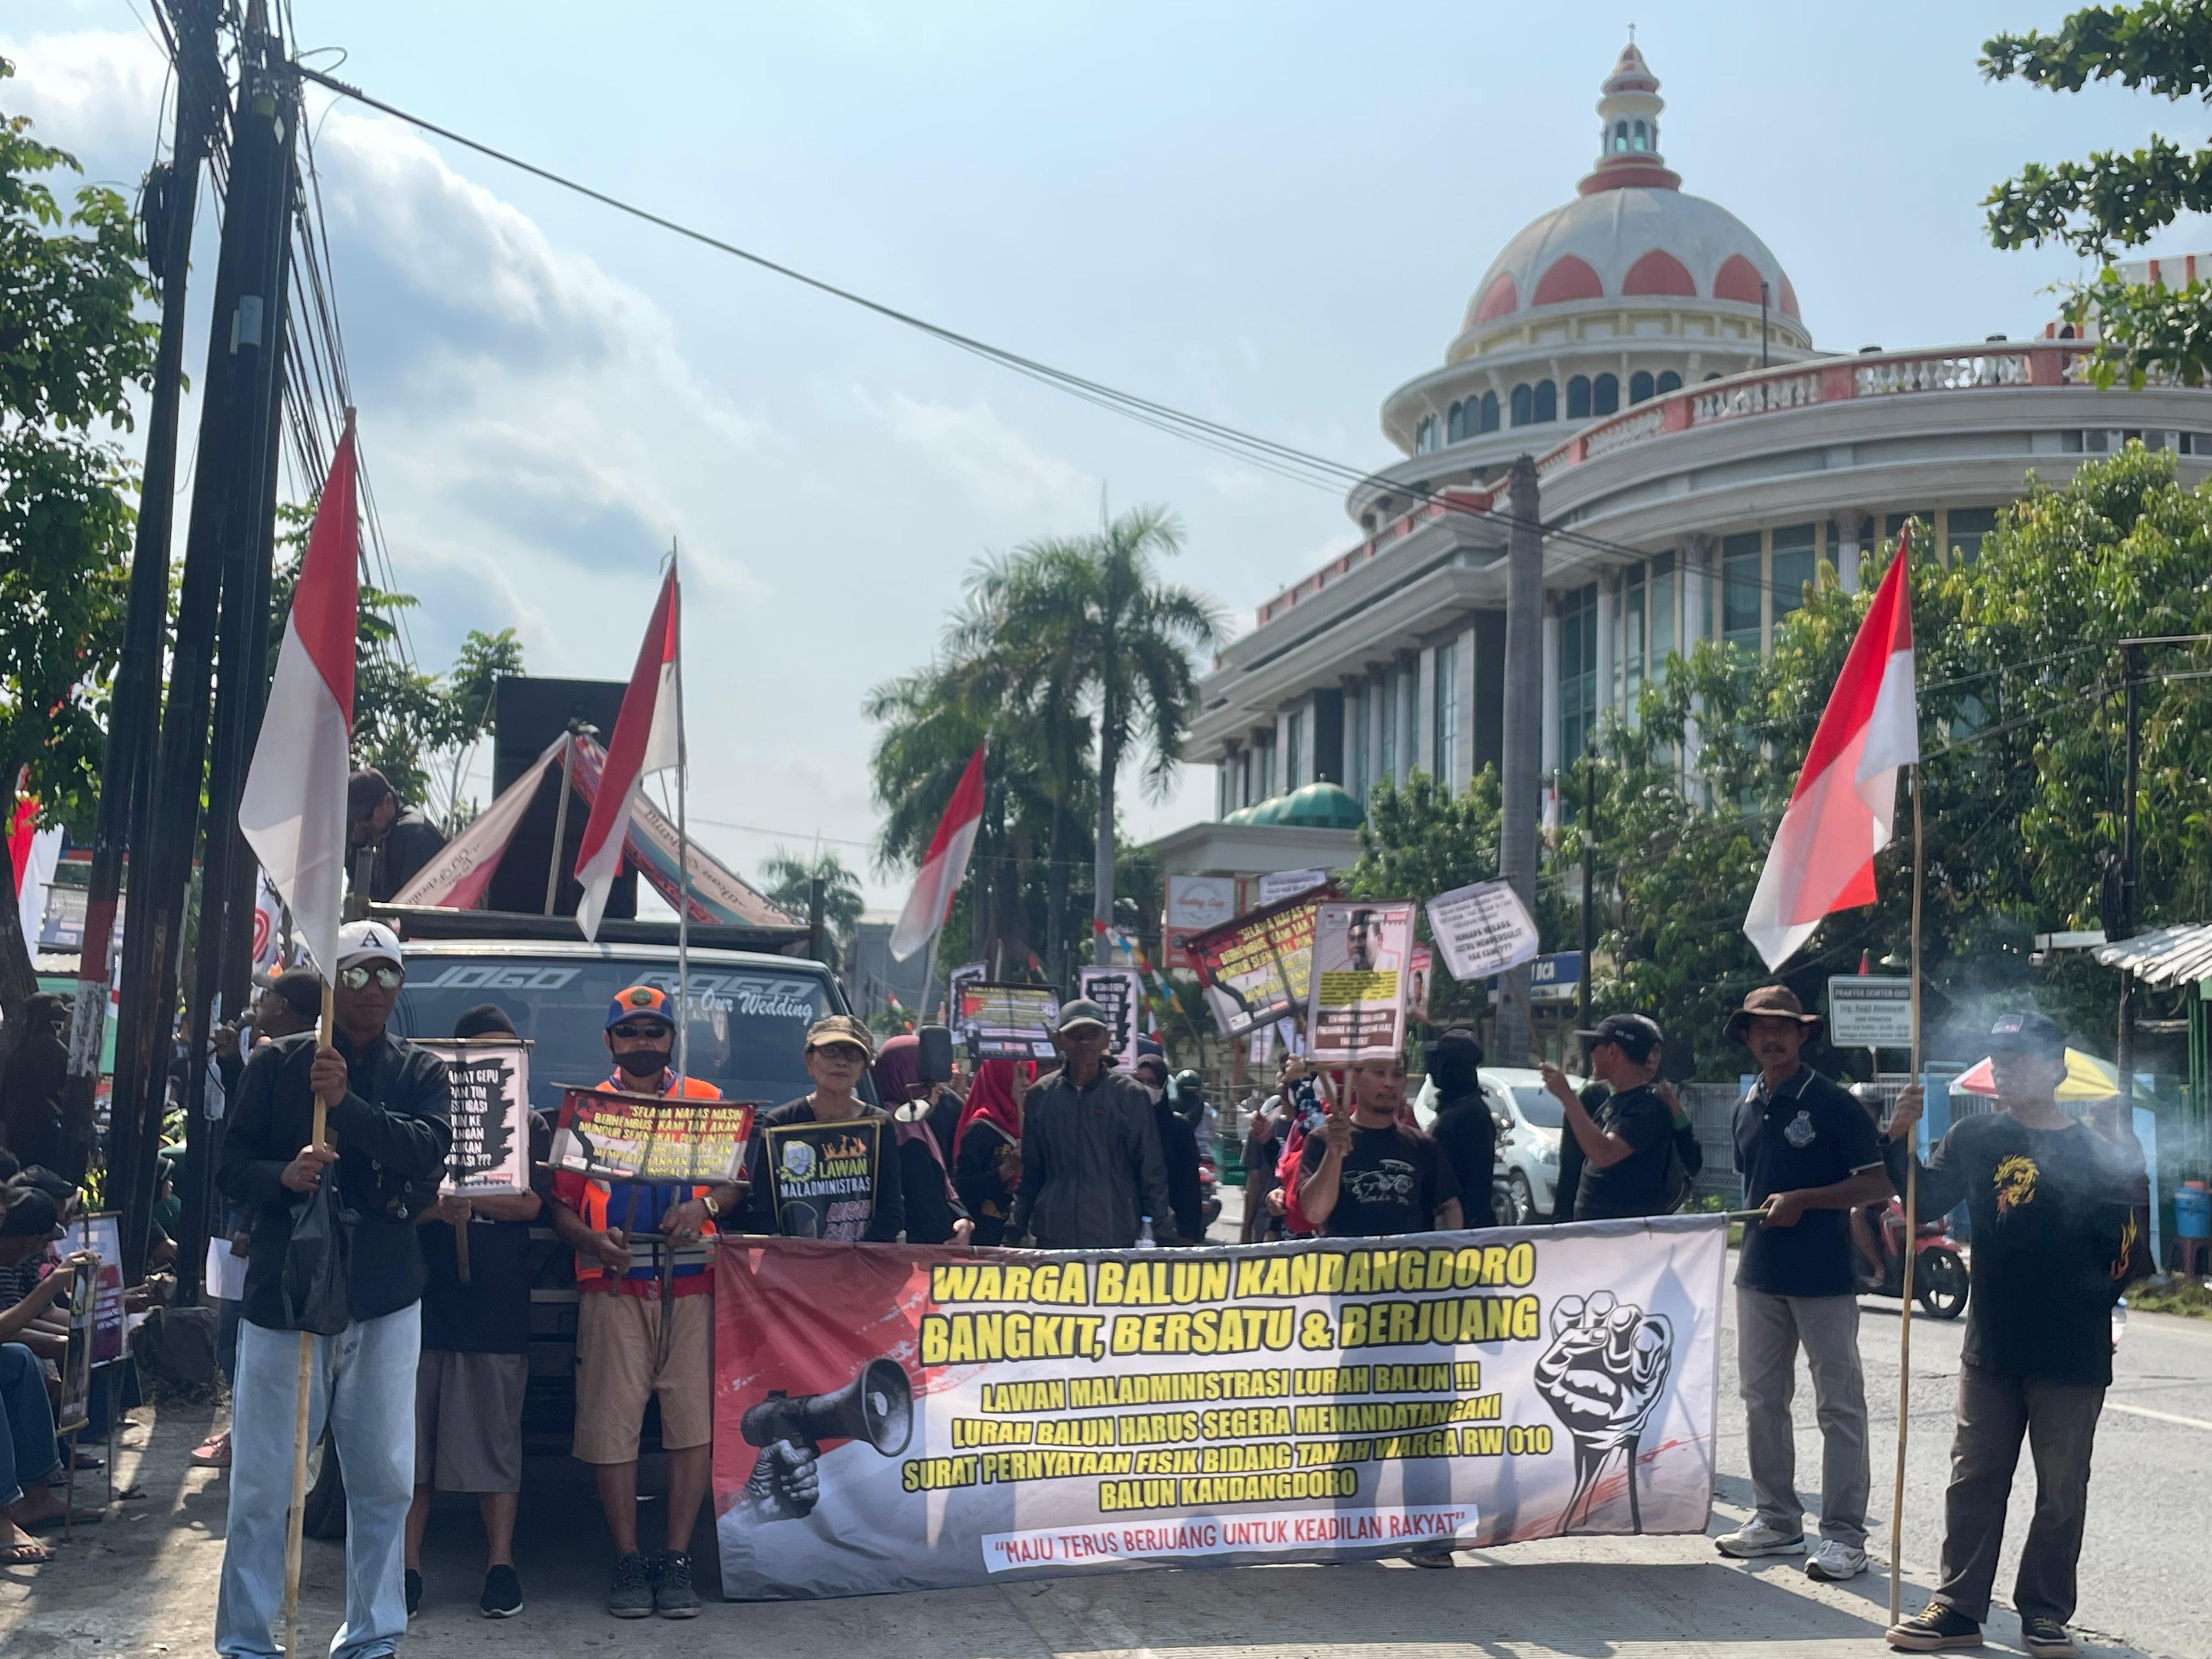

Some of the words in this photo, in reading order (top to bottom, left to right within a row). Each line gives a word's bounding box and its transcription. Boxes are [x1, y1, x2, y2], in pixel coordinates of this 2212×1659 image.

[359, 929, 383, 947] A
[402, 966, 582, 989] JOGO
[1536, 961, 1555, 980] BCA
[701, 988, 734, 1013] Our
[738, 991, 813, 1026] Wedding
[448, 1070, 475, 1085] AMAT
[476, 1069, 499, 1085] CEPU
[469, 1114, 482, 1126] KE
[477, 1153, 492, 1166] ???
[819, 1158, 867, 1178] LAWAN
[933, 1261, 1088, 1304] WARGA
[1095, 1260, 1229, 1305] BALUN
[1235, 1242, 1535, 1299] KANDANGDORO
[921, 1312, 1105, 1364] BANGKIT,
[1111, 1306, 1295, 1355] BERSATU
[1299, 1310, 1335, 1350] &
[1340, 1294, 1539, 1348] BERJUANG
[981, 1379, 1065, 1413] LAWAN
[1069, 1369, 1290, 1409] MALADMINISTRASI
[1294, 1364, 1370, 1397] LURAH
[1374, 1363, 1451, 1393] BALUN
[1454, 1361, 1480, 1391] !!!
[952, 1418, 1033, 1448] LURAH
[1036, 1416, 1115, 1446] BALUN
[1118, 1410, 1199, 1445] HARUS
[1203, 1406, 1292, 1440] SEGERA
[1294, 1393, 1502, 1435] MENANDATANGANI
[902, 1454, 979, 1492] SURAT
[981, 1450, 1133, 1483] PERNYATAAN
[1135, 1447, 1199, 1474] FISIK
[1203, 1444, 1293, 1473] BIDANG
[1296, 1438, 1371, 1468] TANAH
[1374, 1429, 1459, 1459] WARGA
[1462, 1426, 1504, 1455] RW
[1508, 1425, 1553, 1455] 010
[1099, 1479, 1176, 1512] BALUN
[1180, 1468, 1357, 1506] KANDANGDORO
[1058, 1531, 1119, 1559] TERUS
[1124, 1525, 1217, 1552] BERJUANG
[1222, 1520, 1288, 1545] UNTUK
[1294, 1516, 1383, 1543] KEADILAN
